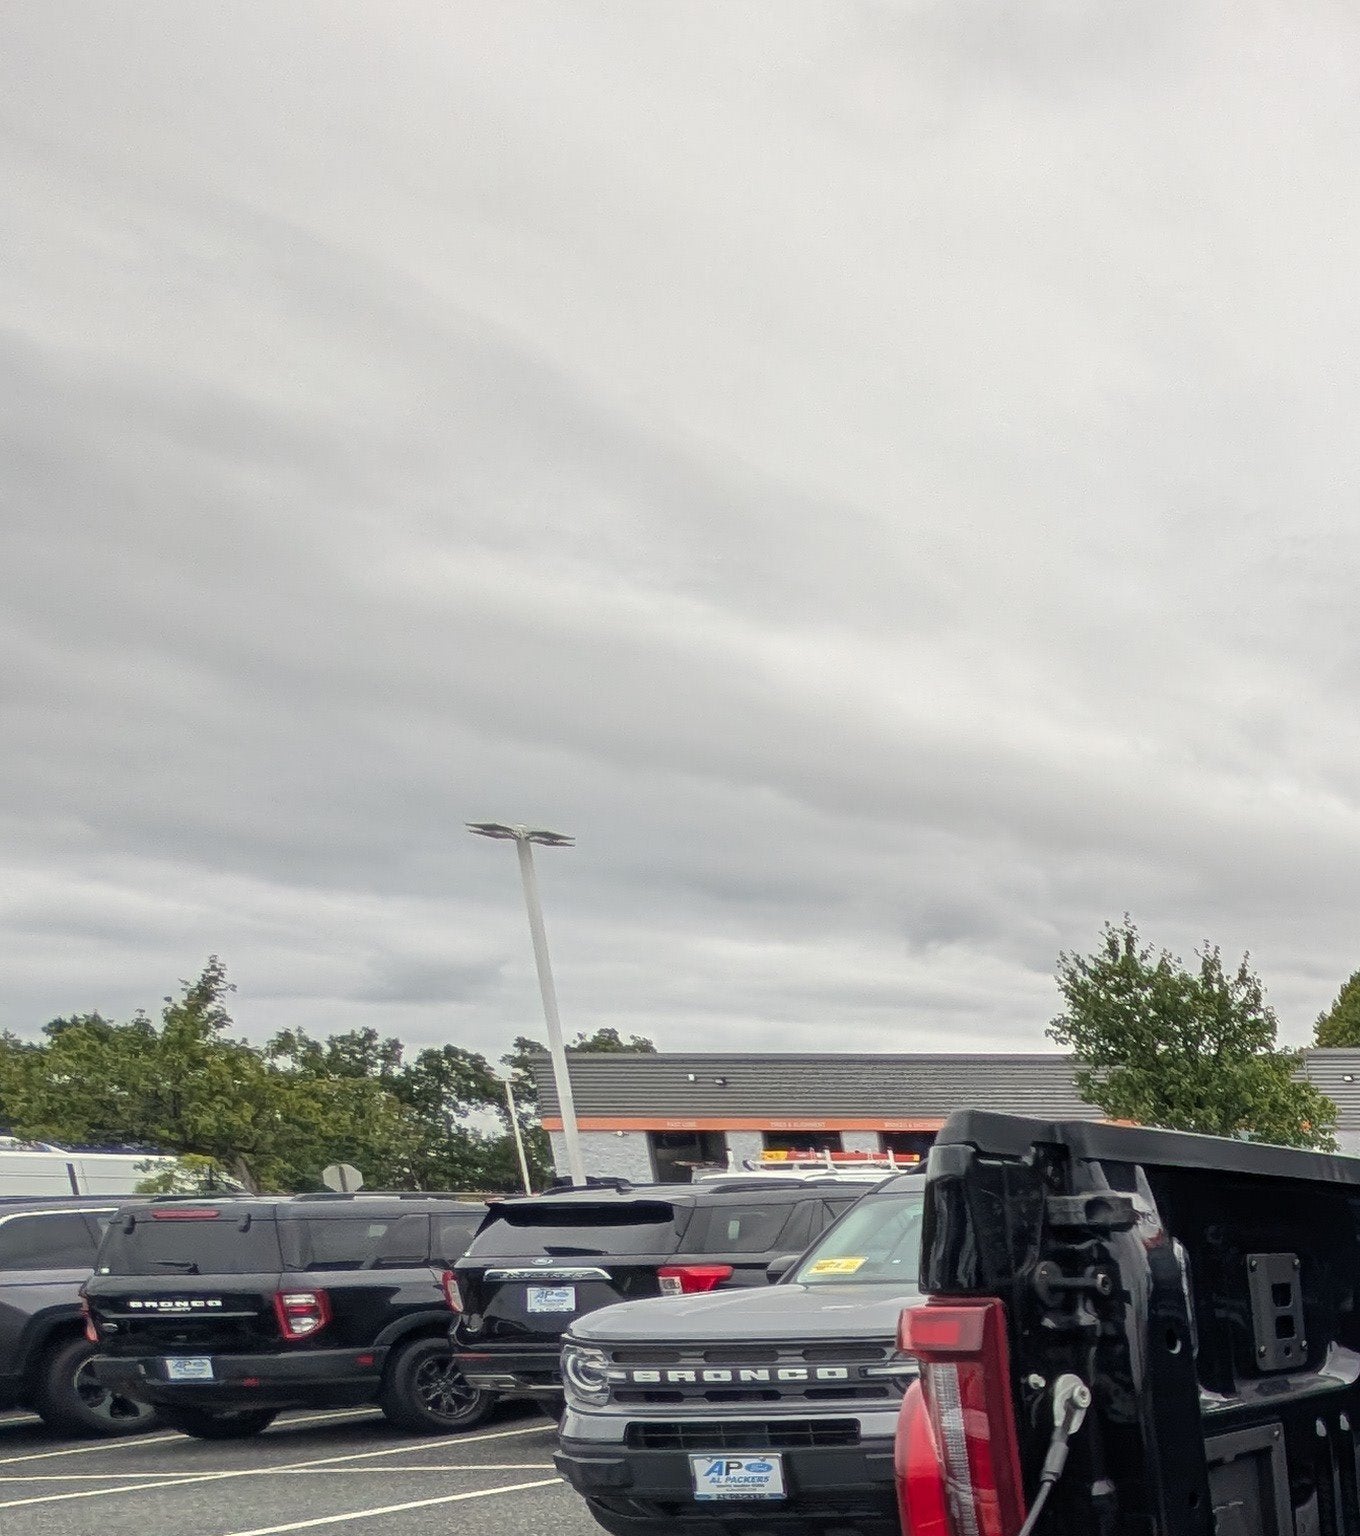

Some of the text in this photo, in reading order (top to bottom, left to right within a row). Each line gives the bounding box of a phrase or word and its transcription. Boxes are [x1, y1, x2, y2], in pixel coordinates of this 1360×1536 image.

[128, 1300, 222, 1308] BRONCO
[633, 1367, 848, 1382] BRONCO
[703, 1461, 743, 1476] AP
[724, 1476, 770, 1484] PACKERS
